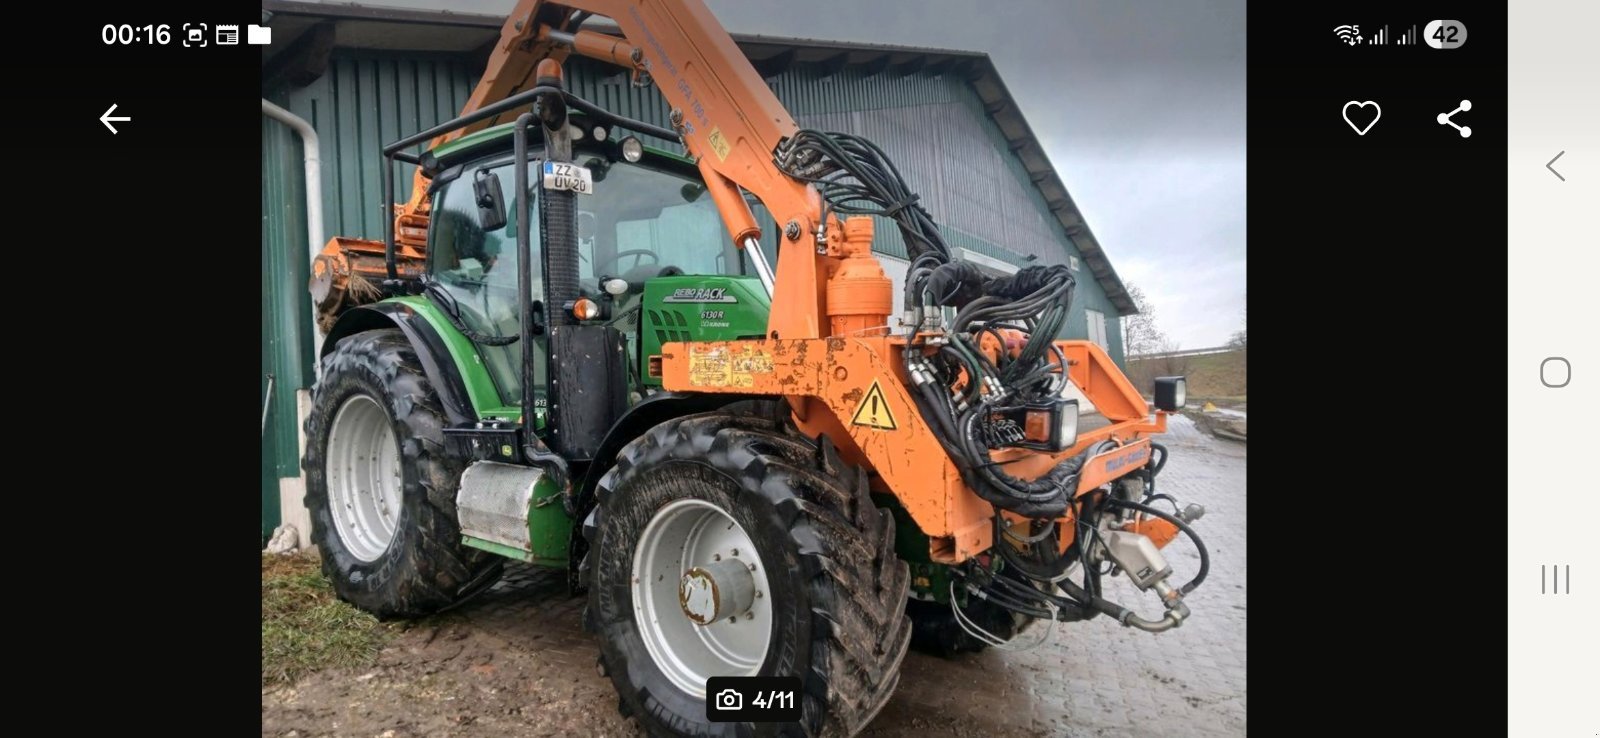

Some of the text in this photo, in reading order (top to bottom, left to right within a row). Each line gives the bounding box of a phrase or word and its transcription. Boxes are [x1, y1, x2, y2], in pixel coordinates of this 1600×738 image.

[102, 24, 171, 45] 00:16
[1432, 26, 1459, 43] 42
[556, 164, 572, 177] ZZ
[695, 288, 726, 300] RACK
